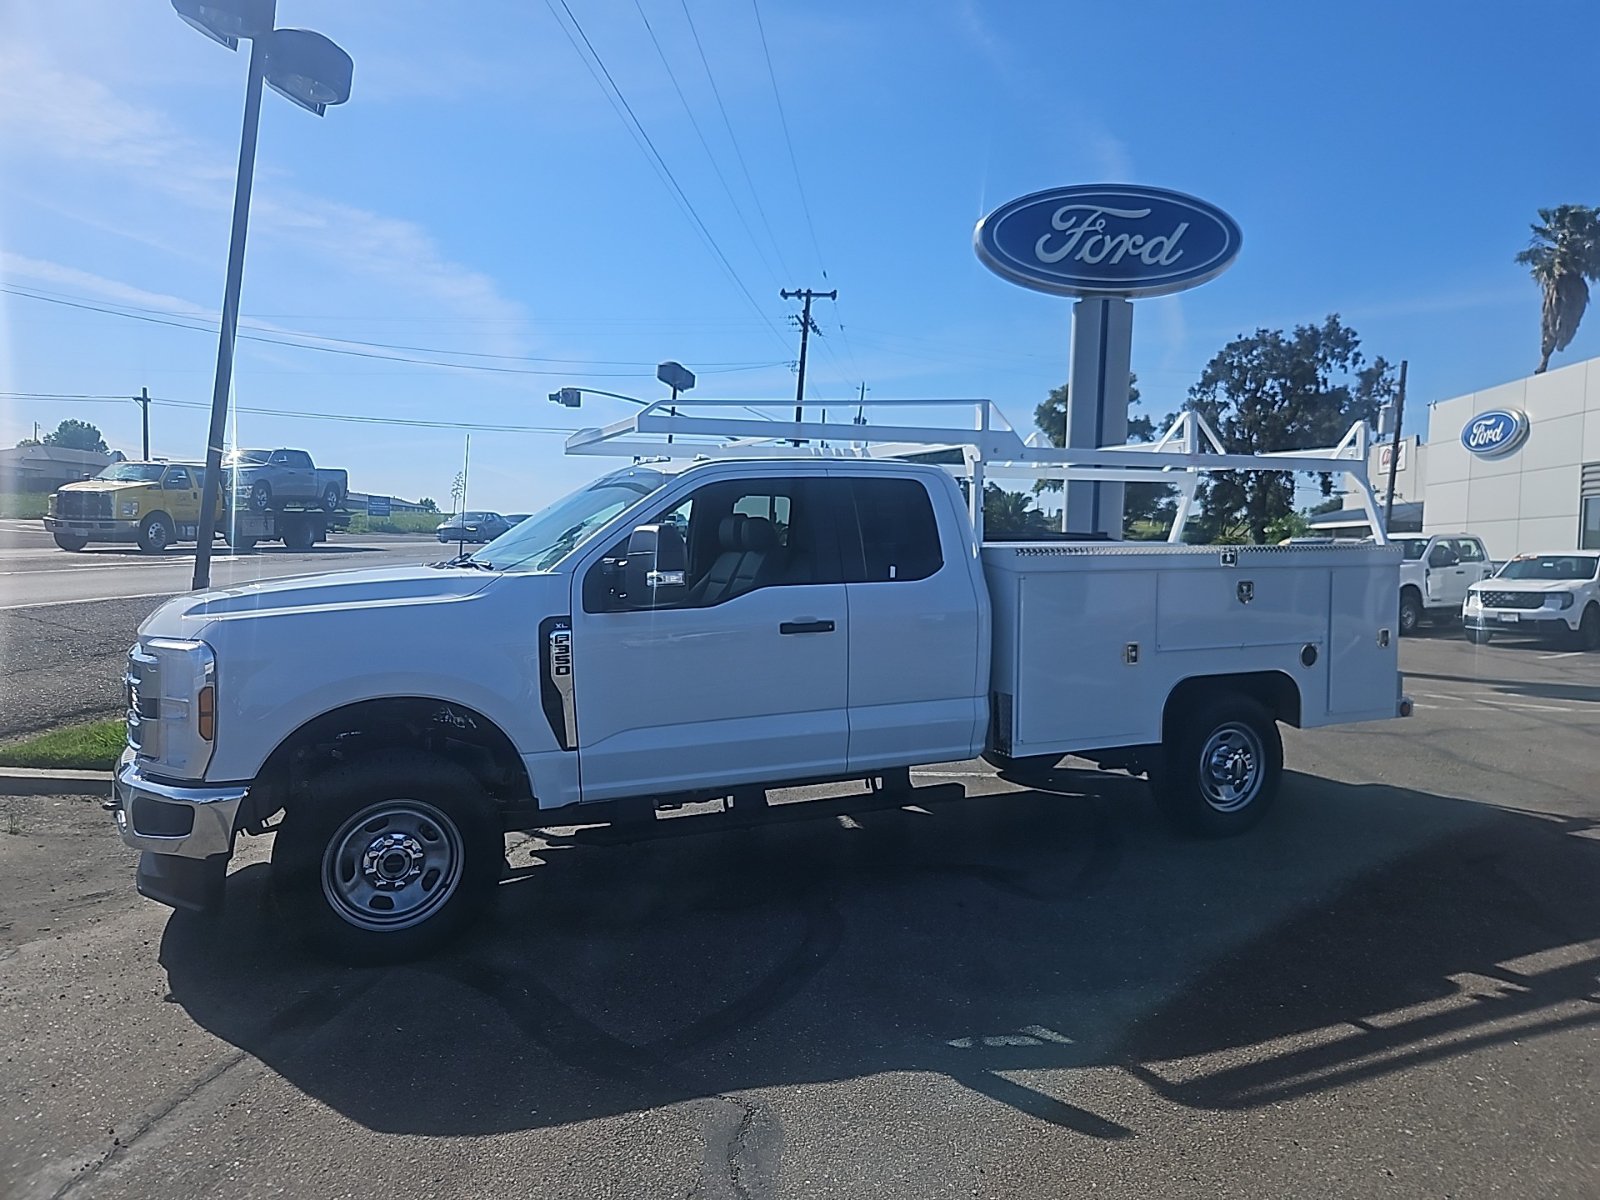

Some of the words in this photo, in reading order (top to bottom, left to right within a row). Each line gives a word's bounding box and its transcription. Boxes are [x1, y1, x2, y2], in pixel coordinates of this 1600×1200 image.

[1034, 204, 1190, 267] Ford
[1469, 417, 1504, 447] Ford
[554, 633, 571, 676] F350
